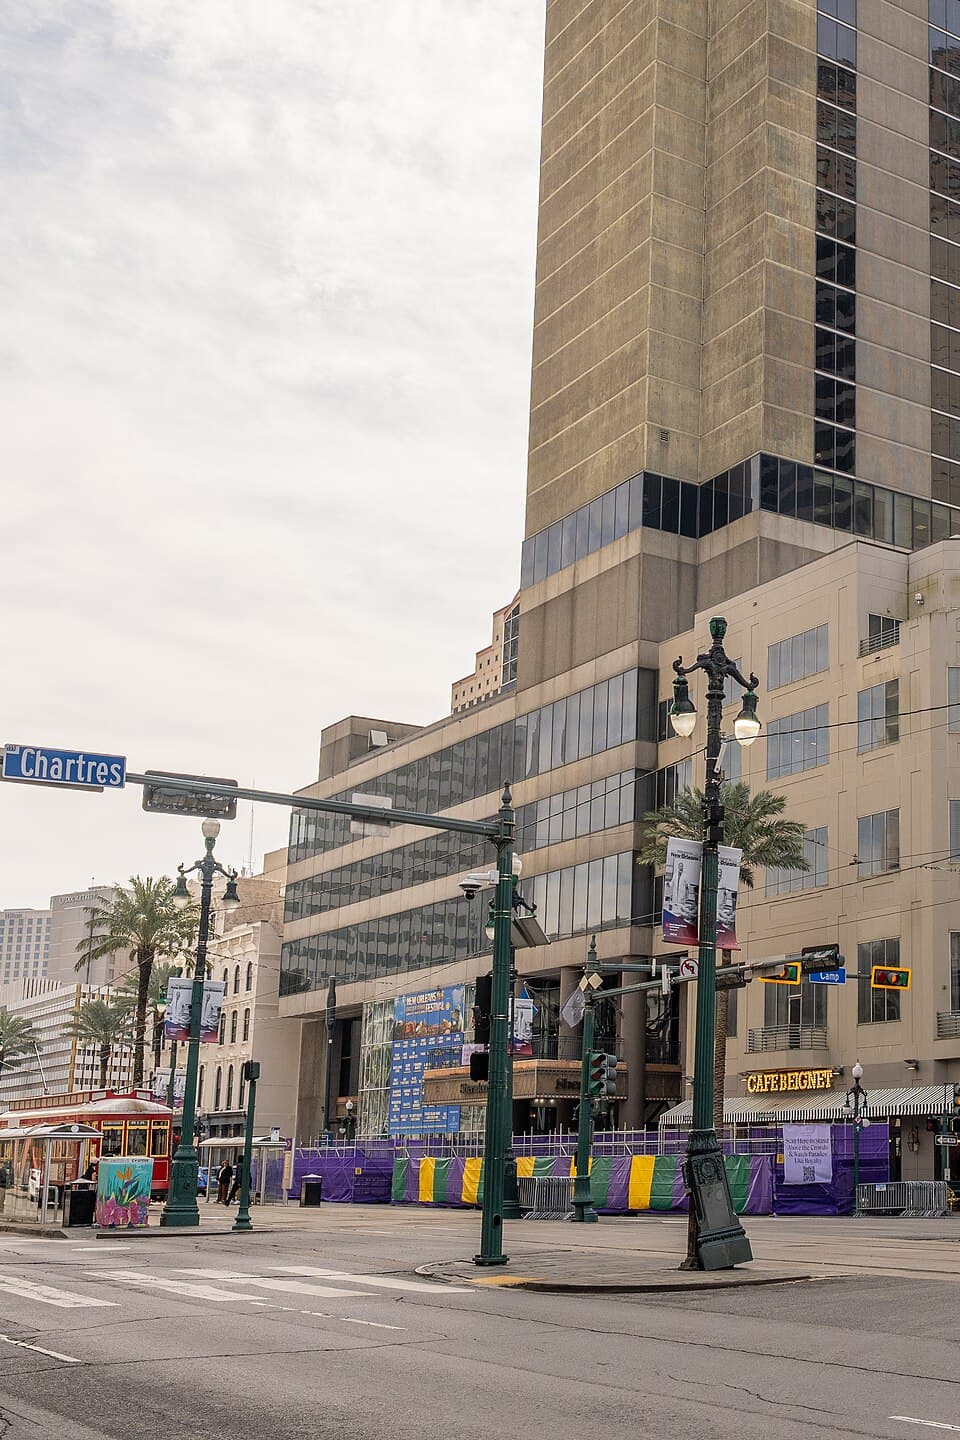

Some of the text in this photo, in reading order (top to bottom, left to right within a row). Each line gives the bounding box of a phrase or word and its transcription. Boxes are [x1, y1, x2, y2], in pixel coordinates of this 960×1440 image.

[20, 747, 122, 786] Chartres
[747, 1069, 833, 1094] CAFE BEIGNET
